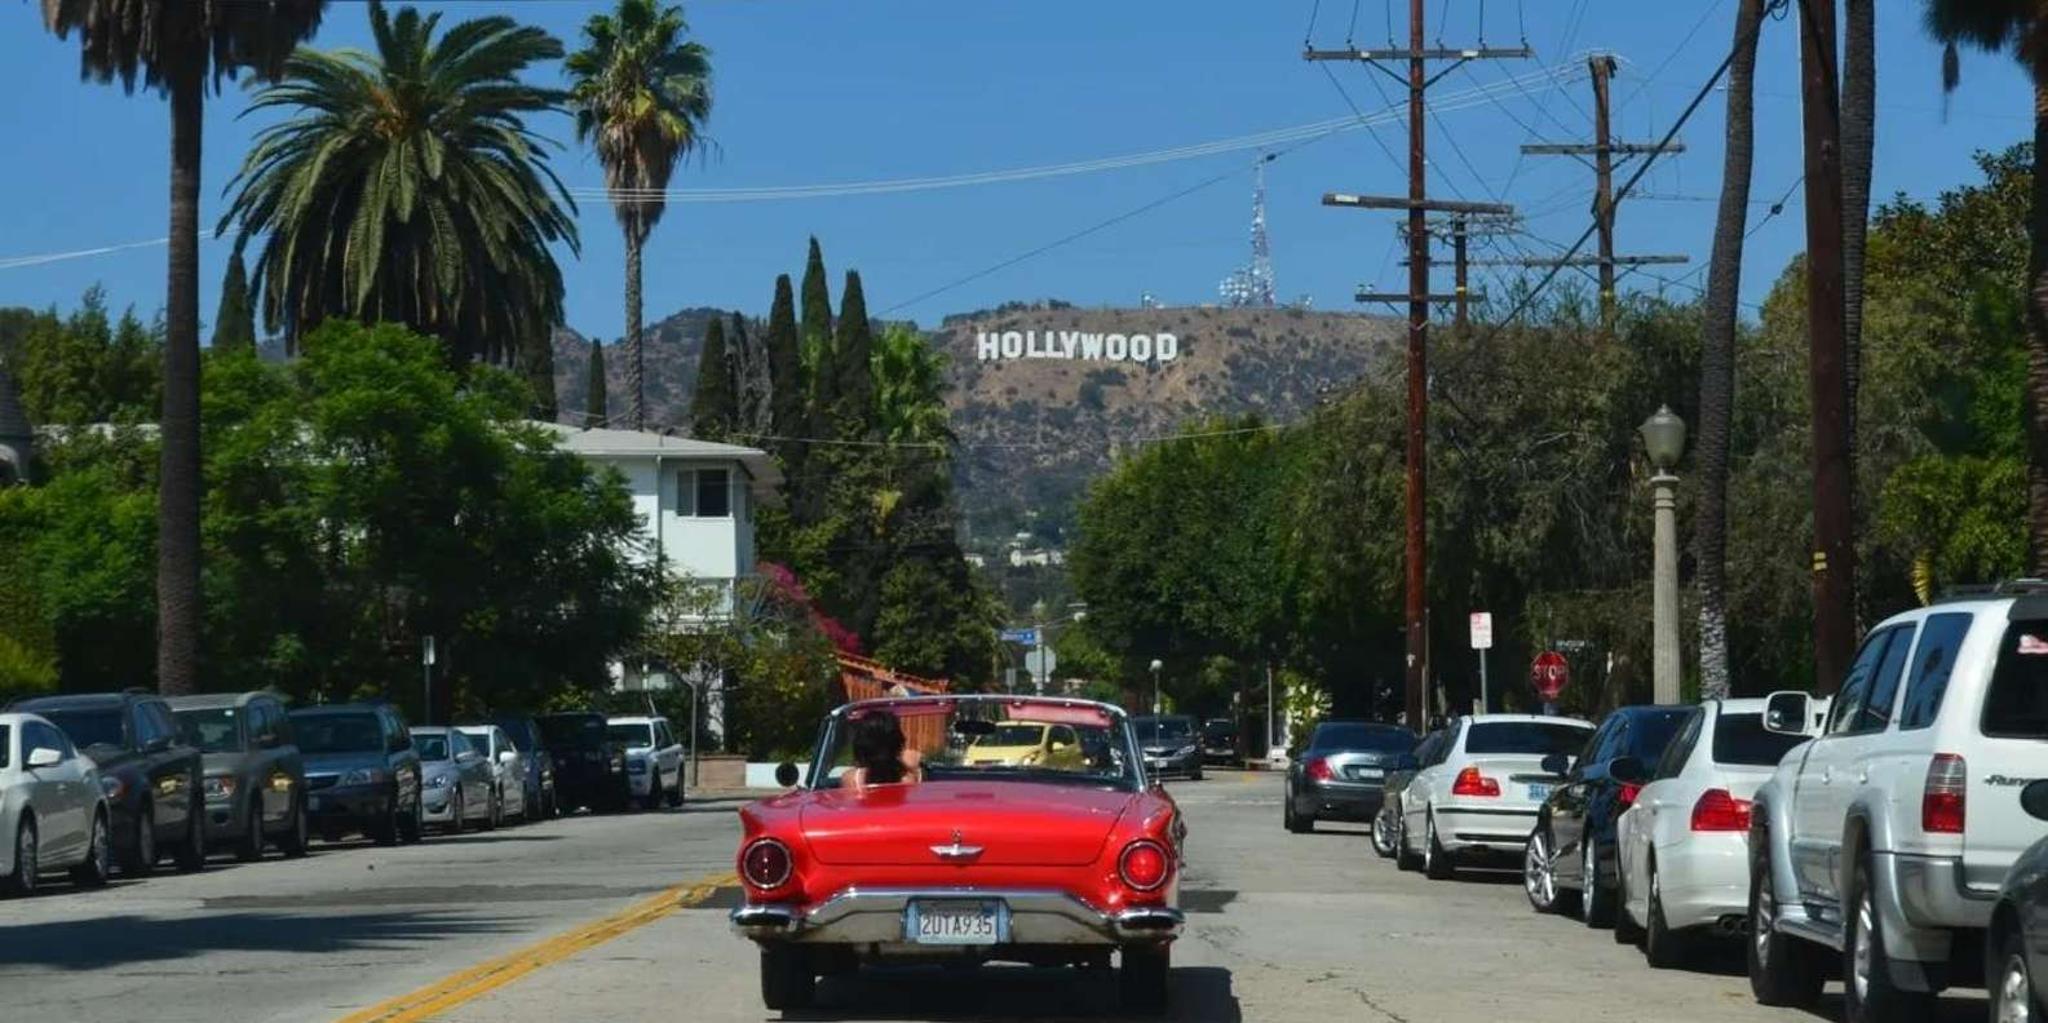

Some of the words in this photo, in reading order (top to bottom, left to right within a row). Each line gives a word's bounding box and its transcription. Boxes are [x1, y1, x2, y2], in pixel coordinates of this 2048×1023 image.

[977, 330, 1178, 361] HOLLYWOOD
[1533, 664, 1566, 680] STOP
[921, 911, 993, 935] 2UTA935
